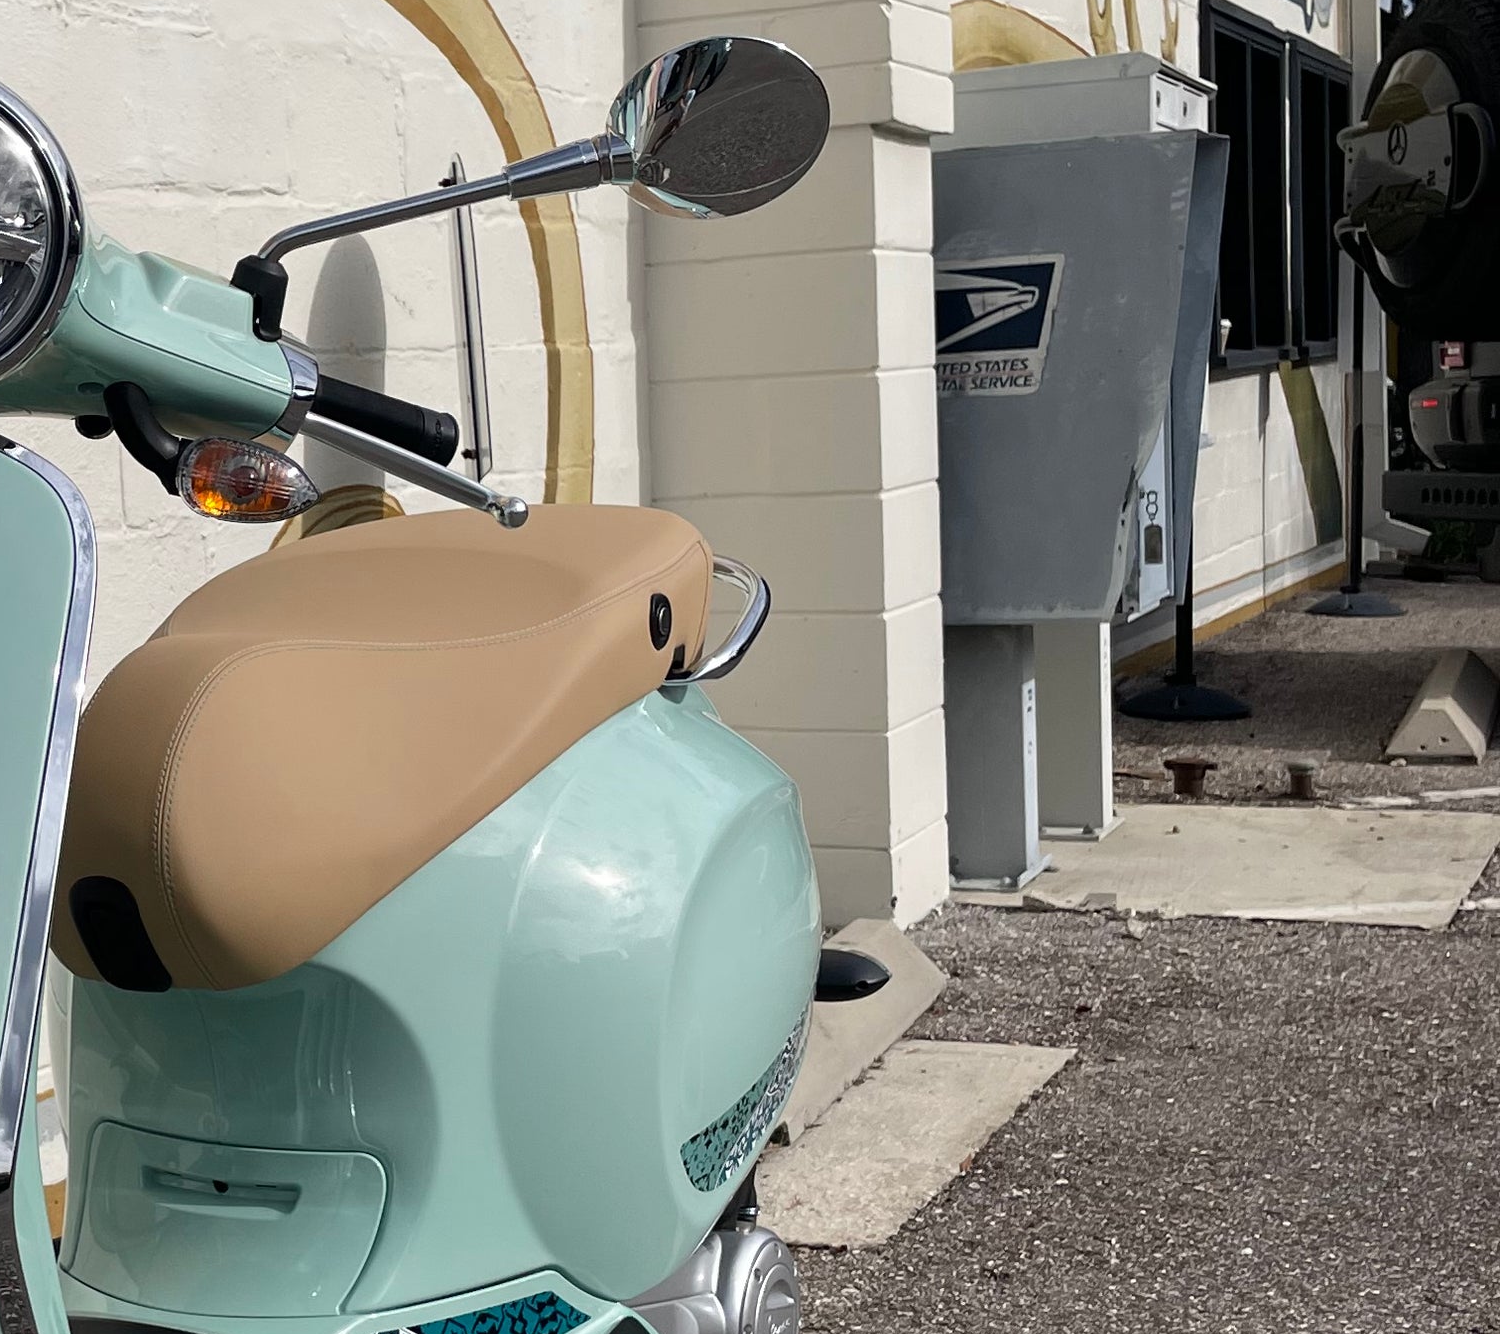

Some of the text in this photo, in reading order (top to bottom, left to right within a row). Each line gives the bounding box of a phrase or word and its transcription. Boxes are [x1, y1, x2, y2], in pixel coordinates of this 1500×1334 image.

[936, 358, 1029, 376] ITED STATES
[970, 375, 1033, 390] SERVICE
